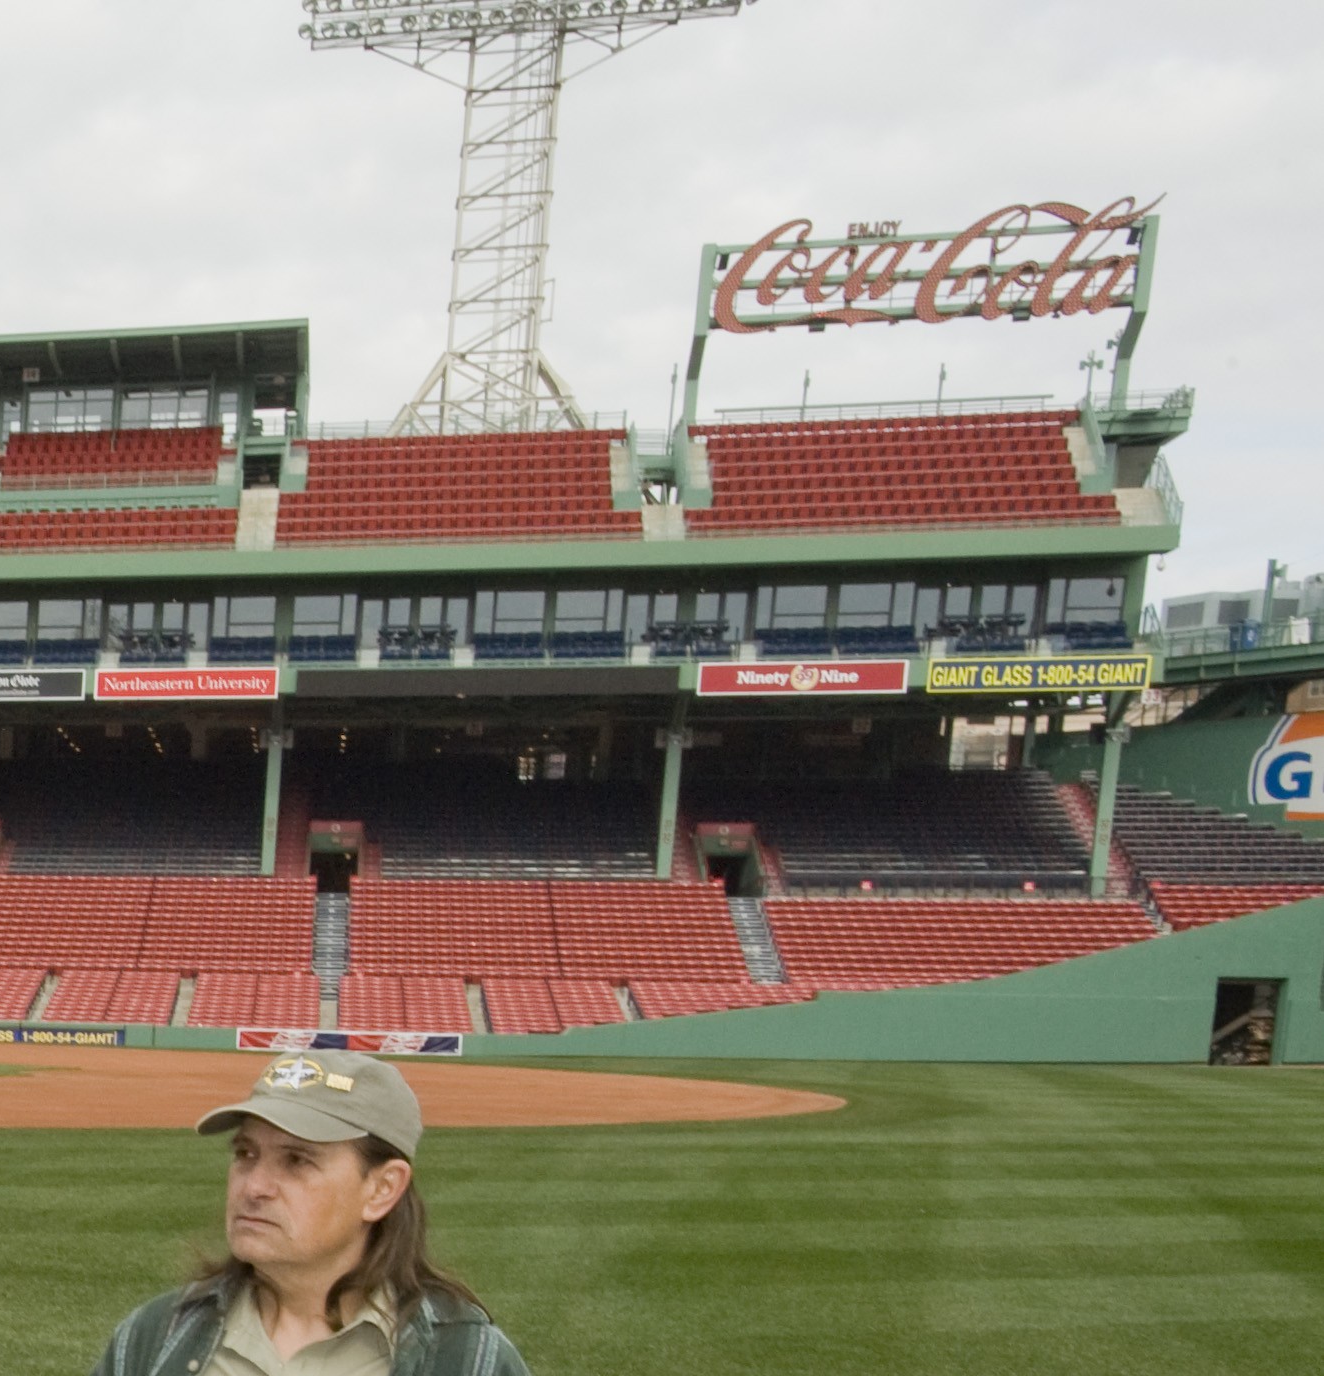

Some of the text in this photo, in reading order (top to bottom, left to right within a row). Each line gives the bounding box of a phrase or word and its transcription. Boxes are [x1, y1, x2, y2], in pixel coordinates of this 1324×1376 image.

[847, 220, 902, 239] ENJOY
[10, 675, 41, 688] Globe
[737, 671, 790, 687] Ninety
[820, 670, 859, 684] Nine
[932, 666, 978, 687] GIANT
[981, 665, 1033, 686] GLASS
[1097, 663, 1146, 684] GIANT
[104, 675, 271, 694] Northeastern University
[22, 1031, 113, 1045] 1-800-54-GIANT
